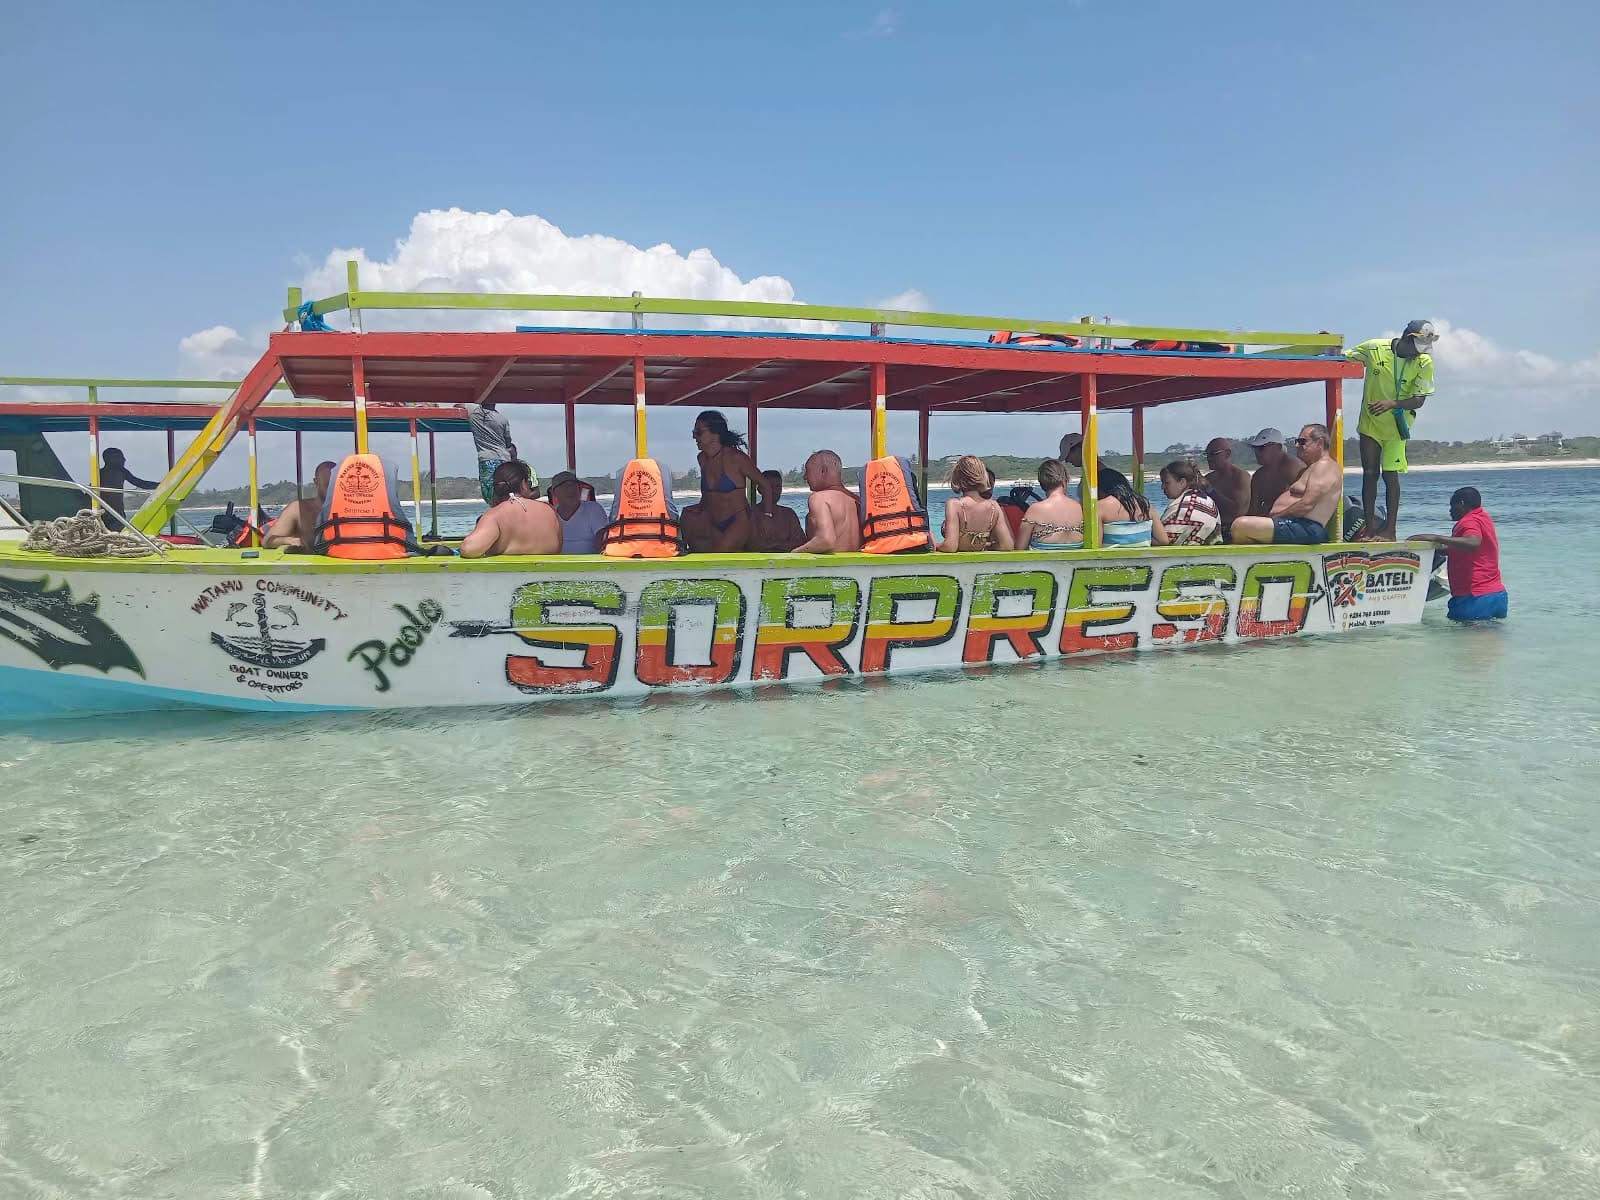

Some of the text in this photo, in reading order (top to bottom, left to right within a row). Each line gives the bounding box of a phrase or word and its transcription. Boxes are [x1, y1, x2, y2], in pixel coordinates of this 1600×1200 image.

[1344, 518, 1365, 542] AMAHA
[1365, 572, 1414, 588] BATELI
[191, 579, 348, 620] WATAMU COMMUNITY
[505, 560, 1314, 695] SORPRESO
[229, 664, 309, 680] BOAT OWNERS
[247, 680, 303, 693] OPERATORS
